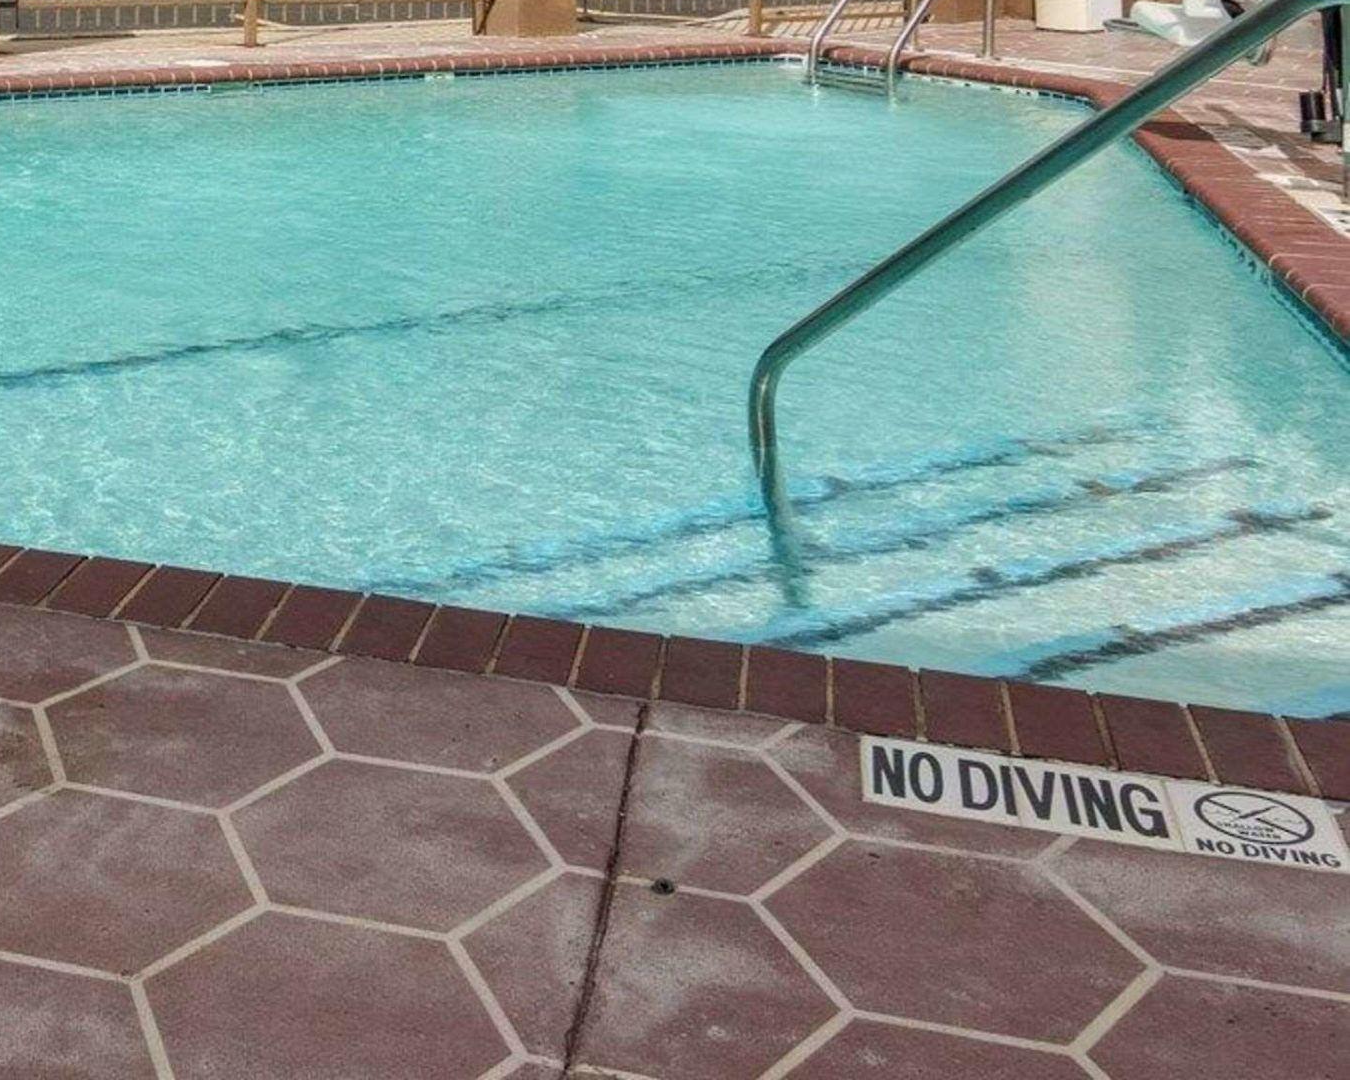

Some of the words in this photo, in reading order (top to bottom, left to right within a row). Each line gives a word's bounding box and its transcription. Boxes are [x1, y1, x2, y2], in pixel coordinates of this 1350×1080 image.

[872, 745, 944, 804] NO
[958, 758, 1170, 839] DIVING
[1196, 837, 1236, 855] NO
[1242, 842, 1342, 869] DIVING
